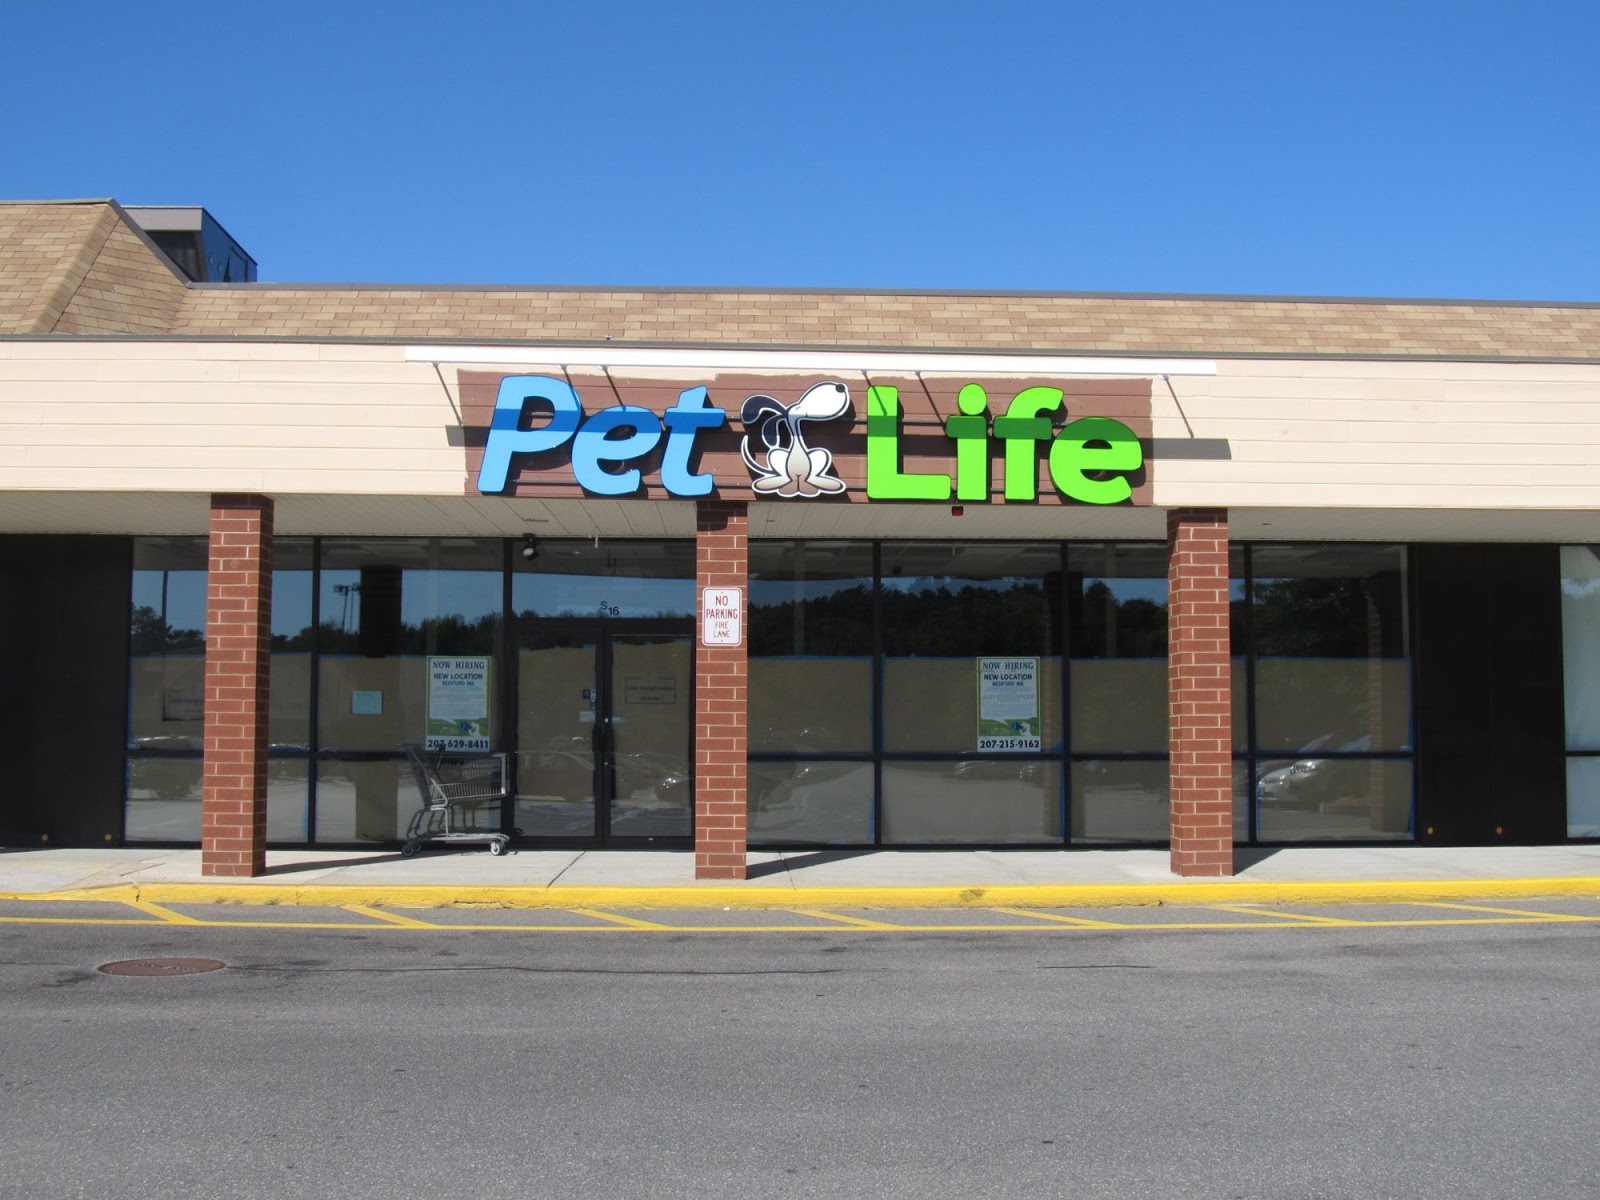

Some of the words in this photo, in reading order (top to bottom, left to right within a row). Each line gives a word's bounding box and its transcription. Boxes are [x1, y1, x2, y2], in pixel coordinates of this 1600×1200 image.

[477, 375, 726, 496] Pet
[866, 383, 1143, 504] Life
[715, 595, 728, 606] NO
[705, 608, 738, 619] PARKING
[714, 621, 728, 629] FIRE
[714, 630, 730, 638] LANE
[432, 661, 451, 670] NOW
[455, 661, 485, 670] HIRING
[982, 661, 1000, 670] NOW
[1004, 661, 1034, 670] HIRING
[984, 673, 998, 681] NEW
[1000, 673, 1032, 681] LOCATION
[427, 739, 489, 749] 207-629-8411
[980, 740, 1040, 749] 207-215-9162
